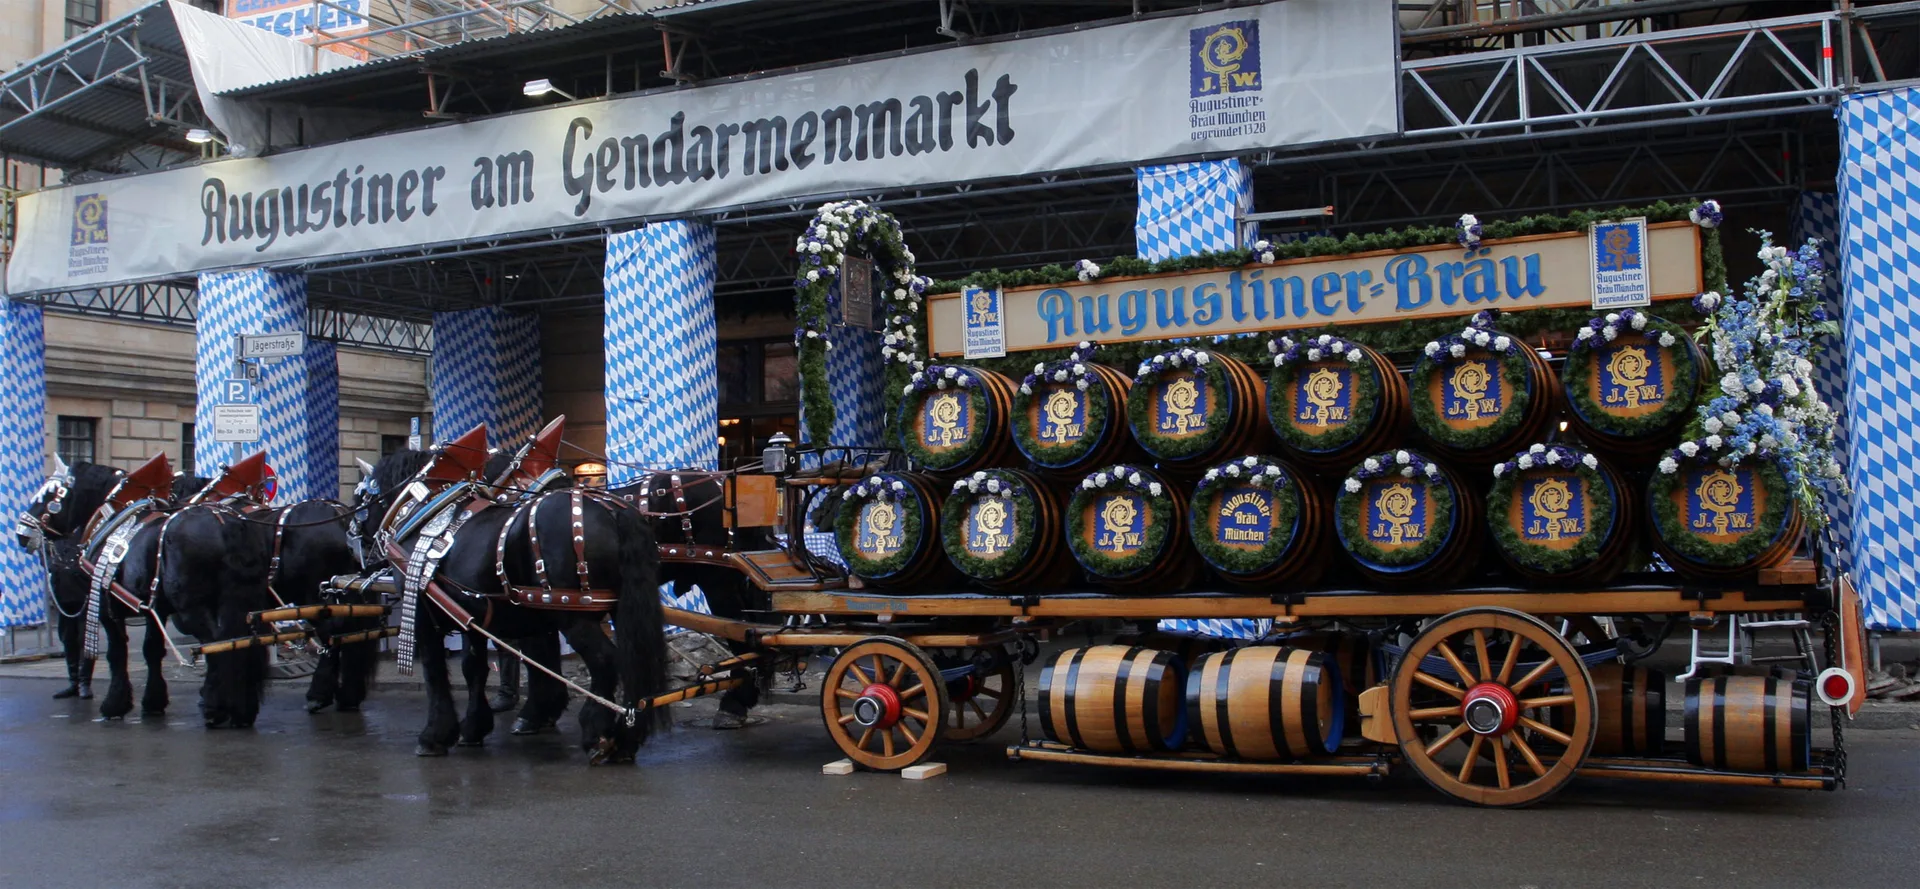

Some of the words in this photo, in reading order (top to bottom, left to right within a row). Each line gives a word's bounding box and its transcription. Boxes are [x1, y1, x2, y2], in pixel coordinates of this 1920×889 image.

[1231, 72, 1259, 87] W.
[1189, 112, 1216, 128] Bräu
[1217, 109, 1266, 125] München
[1190, 126, 1242, 141] gegründet
[1244, 122, 1266, 135] 1328
[201, 164, 446, 252] Augustiner
[471, 149, 535, 211] am
[562, 67, 1019, 217] Gendarmenmarkt
[1614, 283, 1645, 293] München
[251, 338, 295, 353] Jägerstraße
[229, 382, 244, 401] P
[1606, 388, 1624, 403] J.
[1638, 385, 1662, 400] W.
[1300, 406, 1315, 420] J.
[1330, 406, 1348, 420] W.
[1448, 401, 1464, 415] J.
[1480, 399, 1499, 413] W.
[1161, 416, 1176, 430] J.
[1188, 414, 1205, 427] W.
[928, 429, 941, 442] J.
[952, 427, 967, 440] W.
[1041, 426, 1054, 438] J.
[1067, 423, 1083, 437] W.
[1221, 492, 1271, 517] Augustiner
[1234, 511, 1258, 525] Bräu
[1693, 513, 1712, 528] J.
[1729, 513, 1752, 528] W.
[1373, 523, 1388, 537] J.
[1403, 524, 1423, 538] W.
[1527, 520, 1545, 535] J.
[1561, 518, 1582, 533] W.
[864, 536, 875, 548] J.
[887, 535, 901, 548] W.
[972, 535, 985, 547] J.
[996, 534, 1012, 547] W.
[1098, 533, 1112, 546] J.
[1125, 532, 1142, 546] W.
[1224, 528, 1265, 542] München
